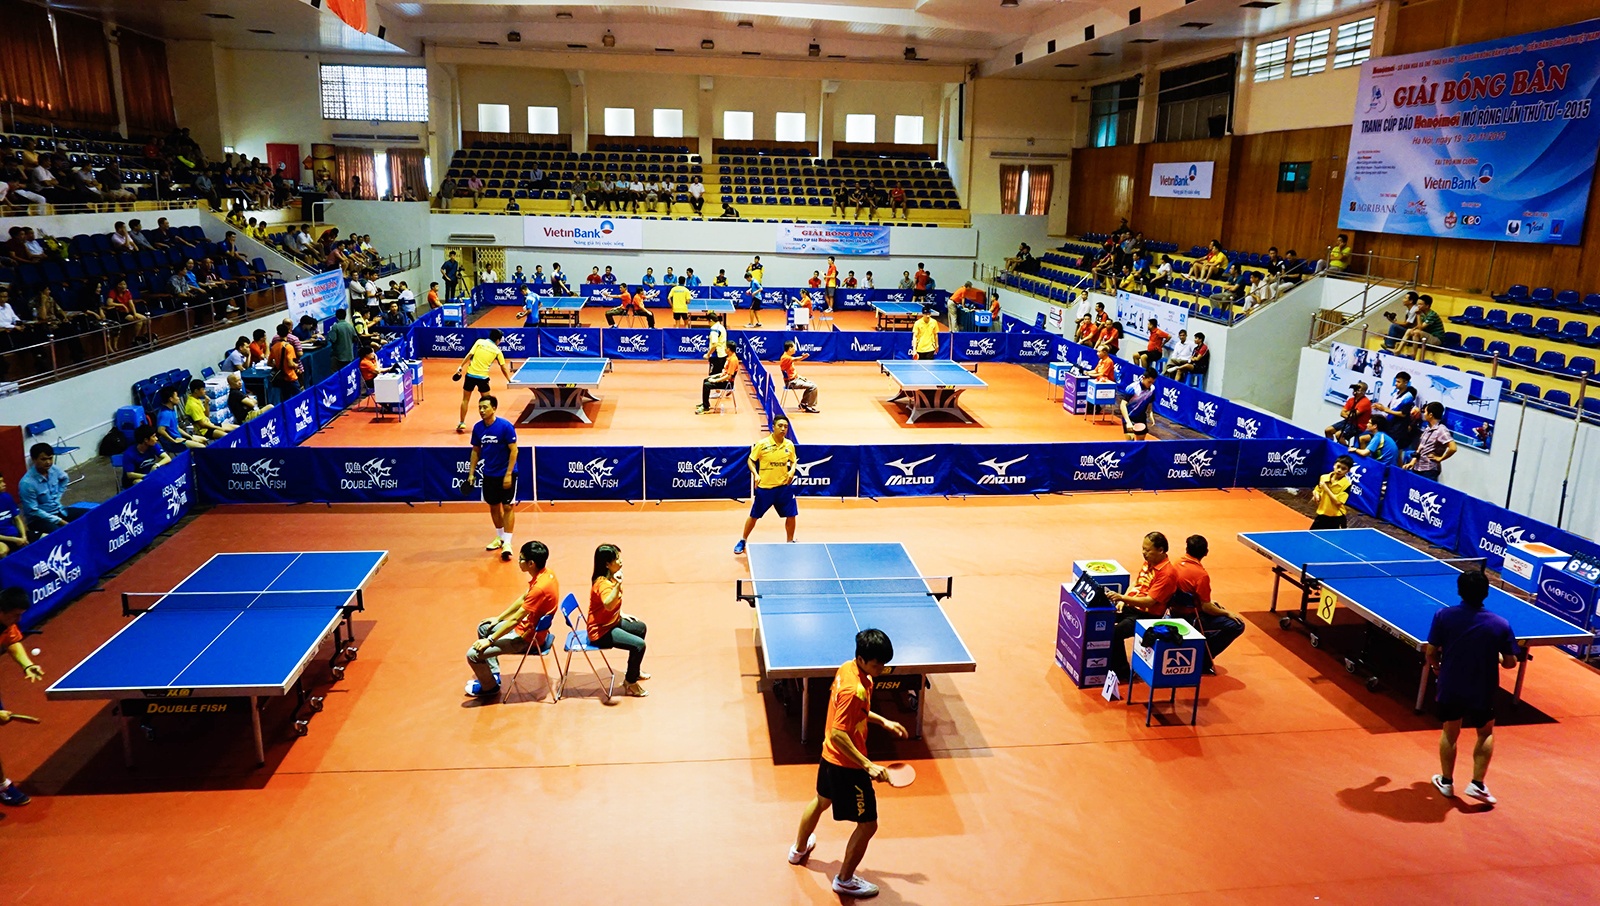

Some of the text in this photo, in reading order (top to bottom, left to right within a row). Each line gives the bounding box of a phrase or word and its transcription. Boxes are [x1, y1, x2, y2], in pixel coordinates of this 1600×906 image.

[1393, 76, 1437, 108] GIẢI
[1442, 72, 1506, 104] BÓNG
[1361, 118, 1383, 133] TRANH
[1383, 115, 1397, 132] CÚP
[1398, 114, 1413, 131] BÁO
[1462, 105, 1478, 127] MỞ
[1478, 106, 1502, 128] RỘNG
[1502, 100, 1521, 124] LẦN
[1522, 100, 1542, 123] THỨ
[1563, 98, 1591, 120] 2015
[1454, 134, 1461, 142] 19
[1424, 176, 1478, 190] VietinBank
[1356, 203, 1398, 213] AGRIBANK
[543, 227, 601, 239] VietinBank
[1074, 470, 1124, 481] DOUBLE FISH
[1168, 468, 1216, 479] DOUBLE FISH
[1260, 466, 1308, 477] DOUBLE FISH
[228, 479, 286, 490] DOUBLE FISH
[340, 479, 398, 490] DOUBLE FISH
[563, 478, 619, 489] DOUBLE FISH
[672, 477, 727, 488] DOUBLE FISH
[884, 475, 934, 486] MIZUNO
[977, 475, 1026, 485] MIZUNO
[1351, 484, 1362, 496] FISH
[1402, 503, 1443, 529] DOUBLE FISH
[108, 522, 144, 553] DOUBLE FISH
[1568, 559, 1600, 580] 6 3
[32, 565, 81, 604] DOUBLE FISH
[1076, 581, 1095, 602] 1 0
[1547, 585, 1578, 604] MOFICO
[1322, 595, 1333, 620] 8
[876, 681, 900, 690] FISH
[147, 703, 227, 714] DOUBLE FISH
[855, 784, 865, 816] STIGA
